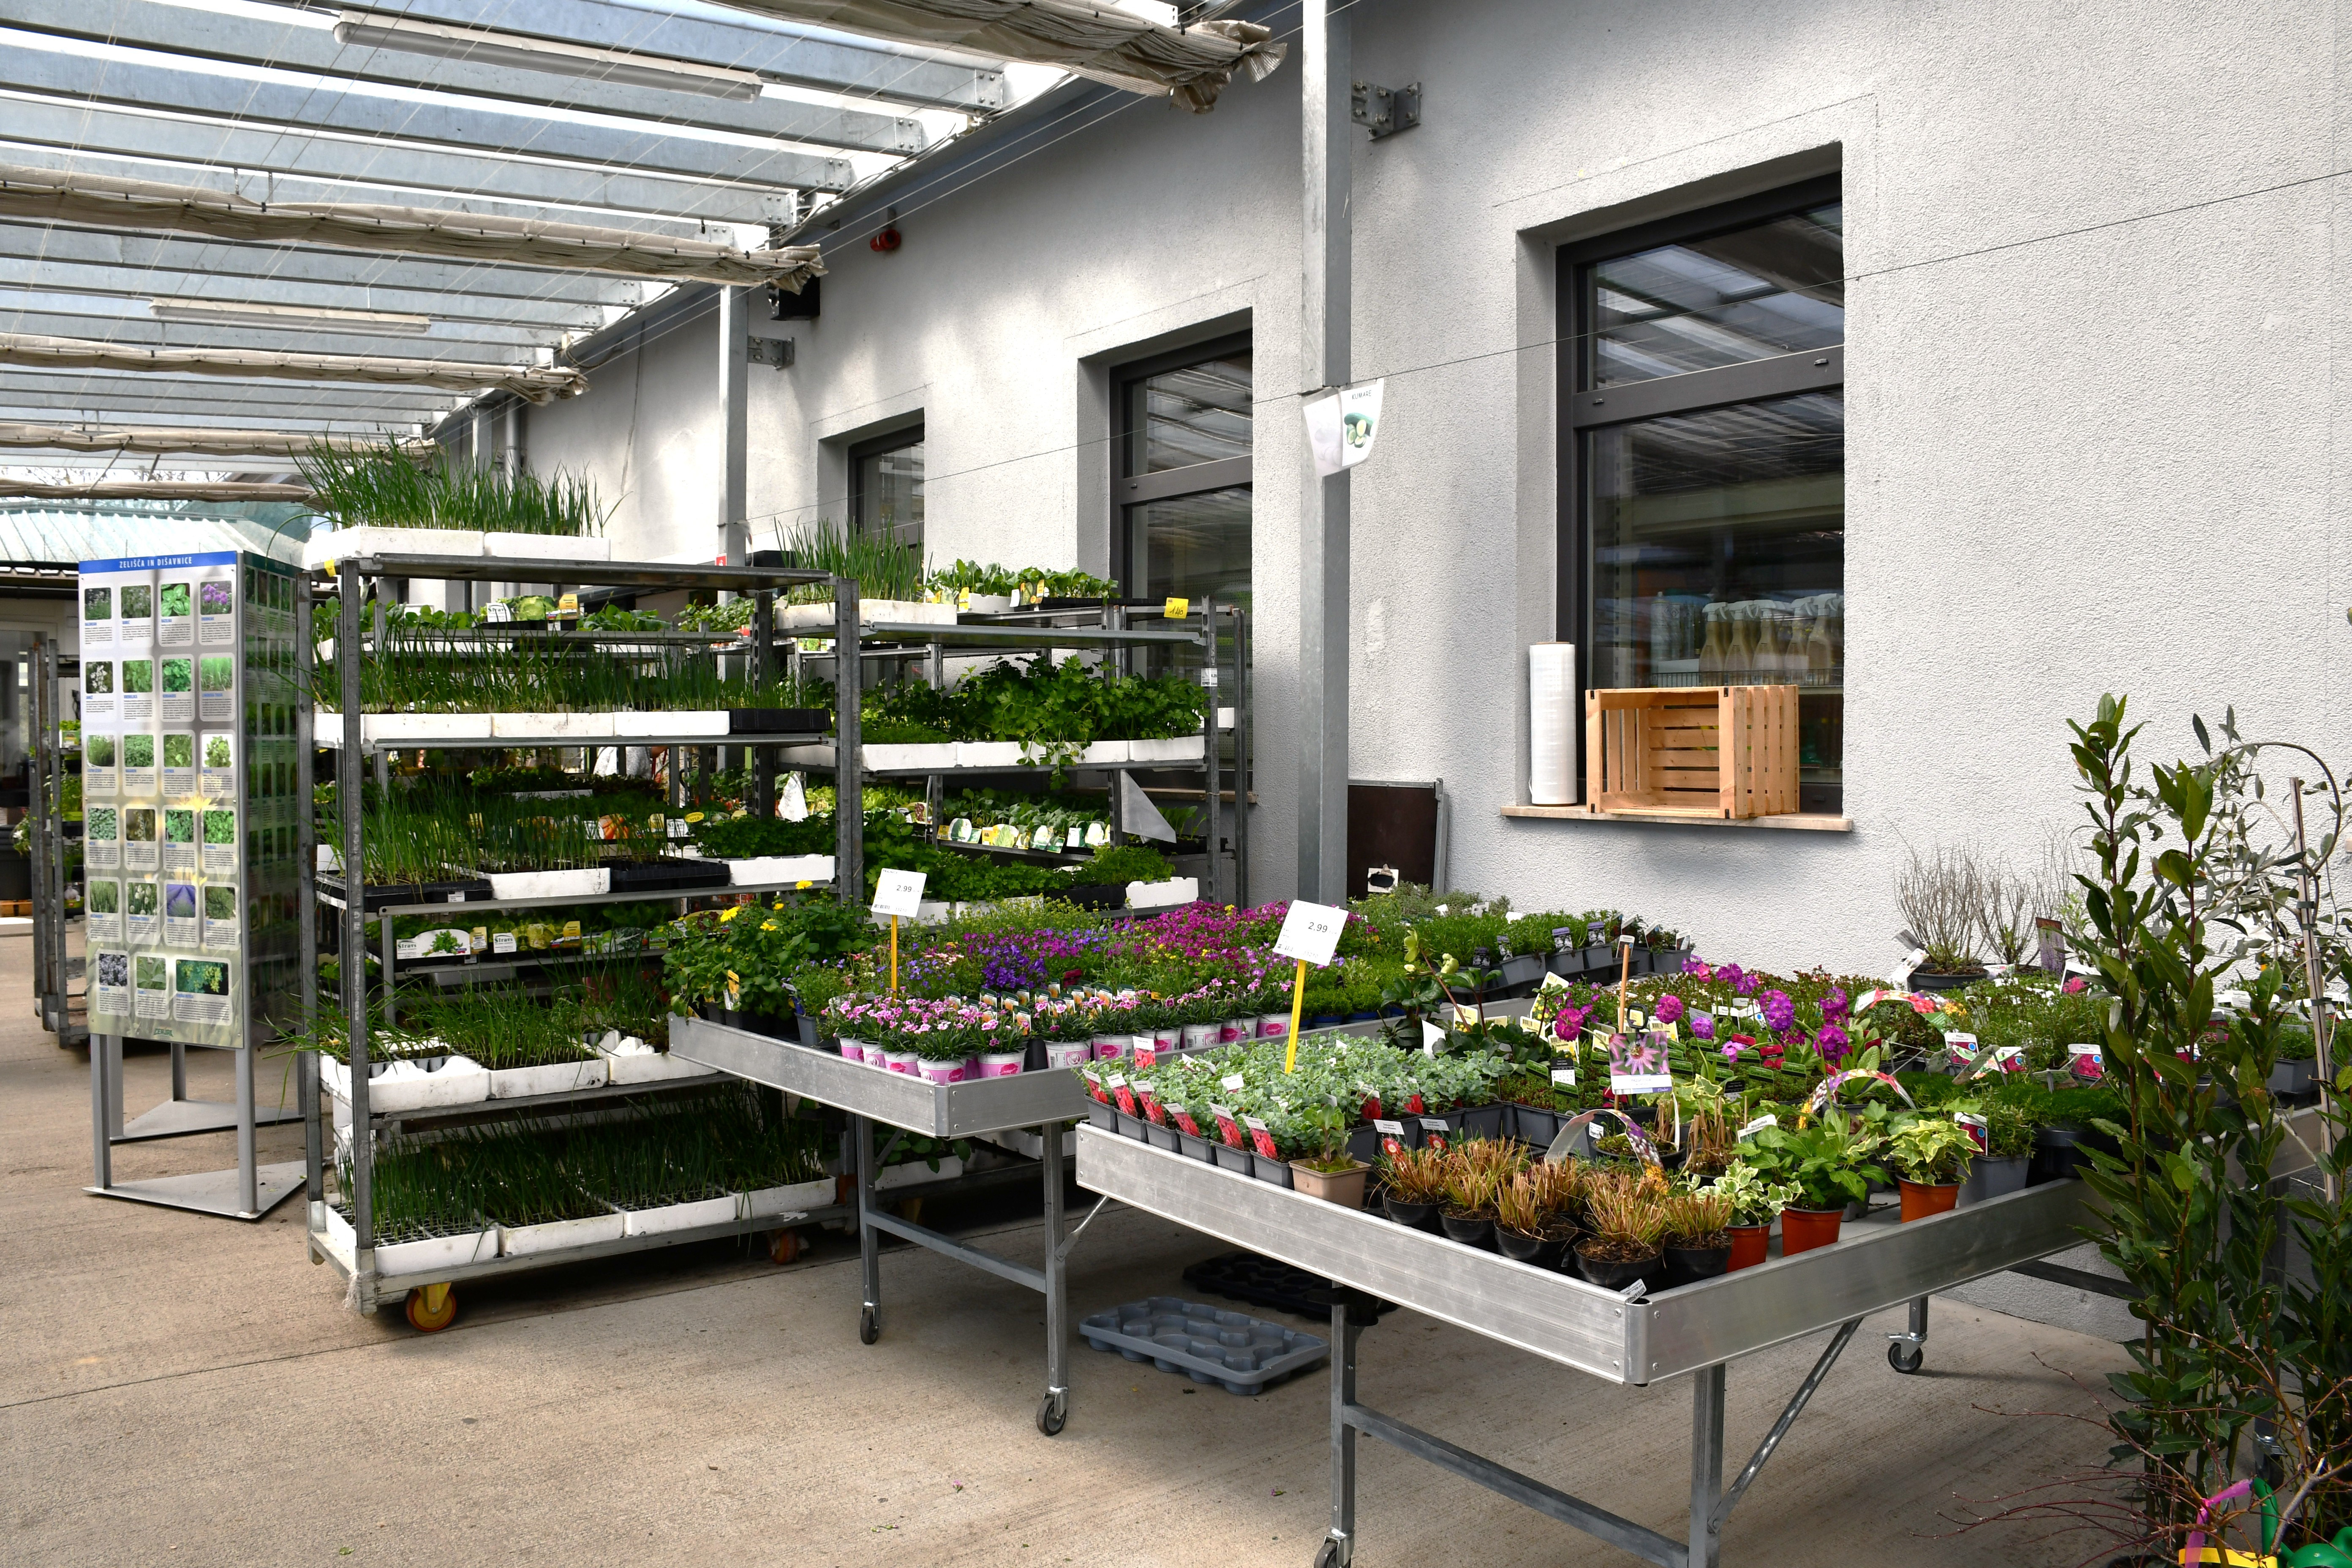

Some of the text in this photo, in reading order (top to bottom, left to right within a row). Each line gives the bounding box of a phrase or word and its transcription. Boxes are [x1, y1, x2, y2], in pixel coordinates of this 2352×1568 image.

[1352, 390, 1372, 400] KUMARE
[119, 559, 145, 568] ZELIŠČA
[157, 557, 192, 566] DIŠAVNICE
[1308, 922, 1328, 933] 2,99
